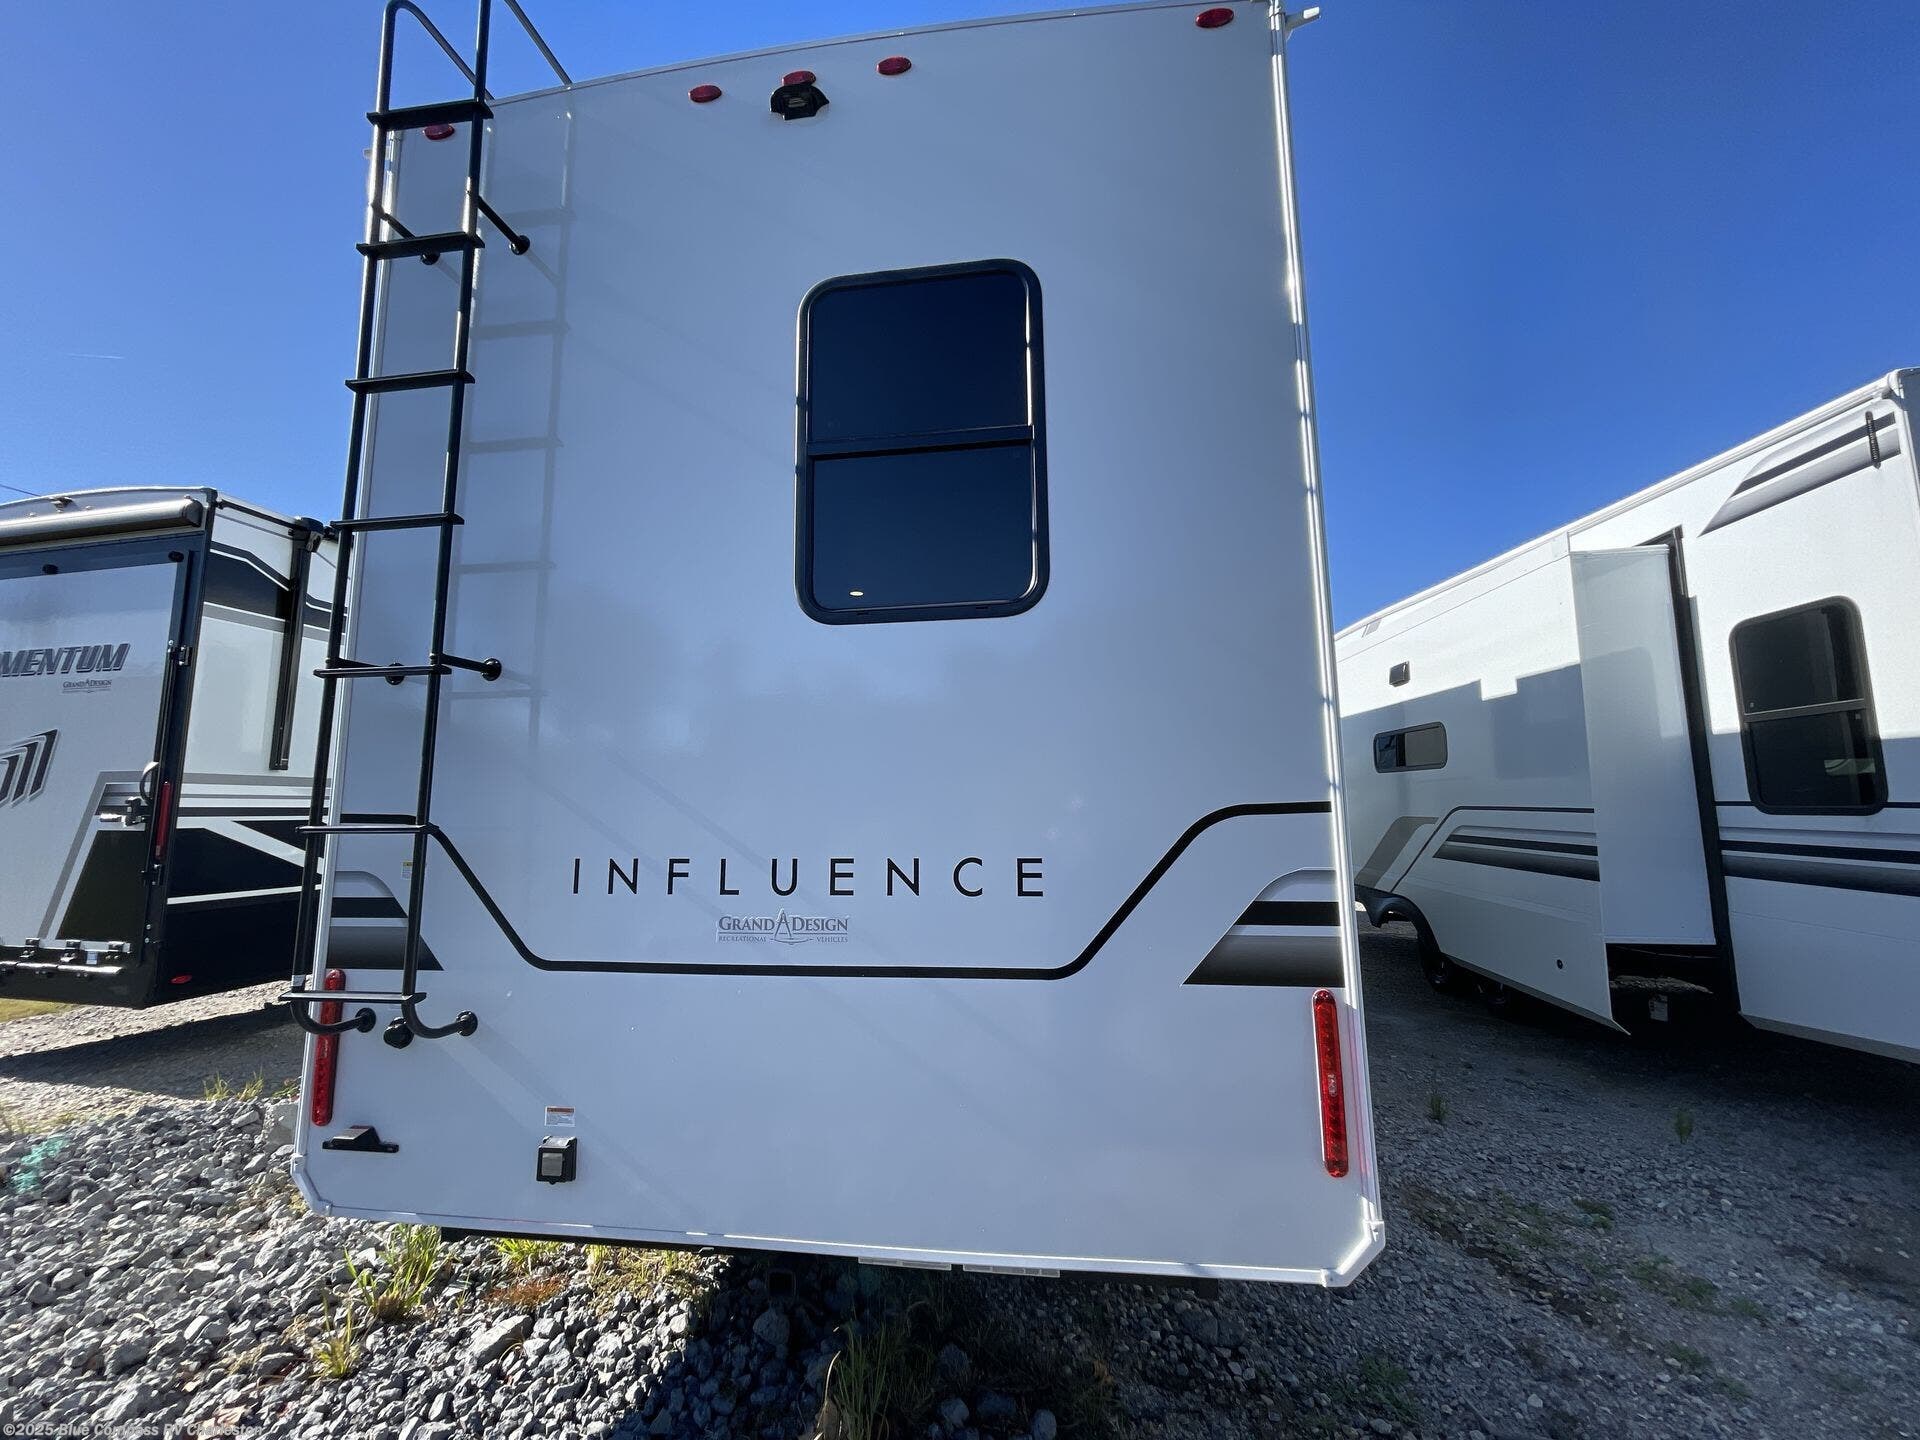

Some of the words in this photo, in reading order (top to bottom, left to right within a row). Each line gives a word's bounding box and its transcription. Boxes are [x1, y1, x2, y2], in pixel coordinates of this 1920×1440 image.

[572, 856, 1045, 898] INFLUENCE
[718, 915, 775, 931] GRAND
[791, 916, 849, 931] DESIGN
[718, 935, 767, 943] RECREATIONAL
[816, 935, 849, 943] VEHICLES
